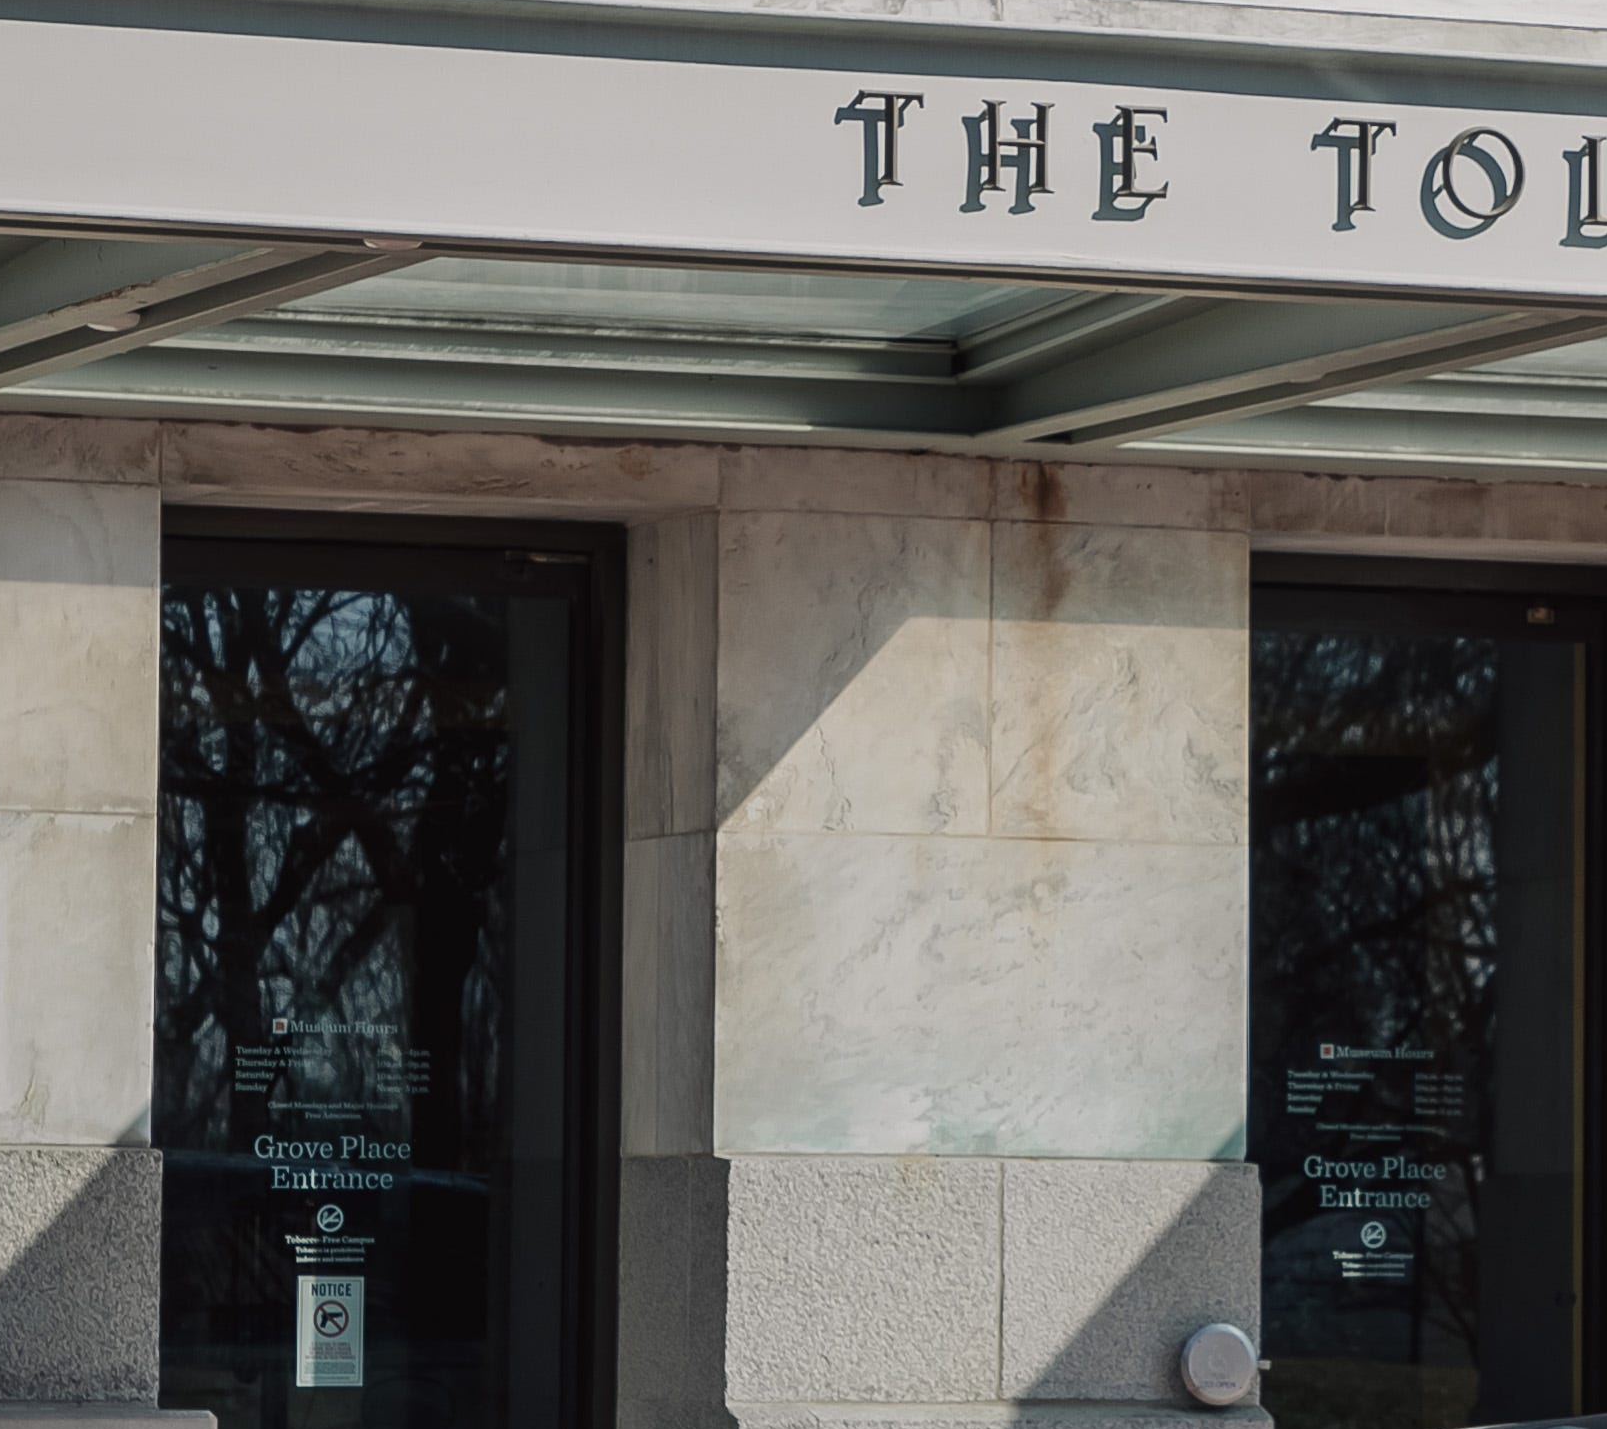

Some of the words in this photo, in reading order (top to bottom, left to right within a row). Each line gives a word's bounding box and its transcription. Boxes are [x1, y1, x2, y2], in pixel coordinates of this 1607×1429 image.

[852, 88, 1171, 201] THE
[291, 1020, 350, 1034] Museum
[355, 1021, 398, 1035] Hours
[235, 1046, 273, 1057] Tuesday
[1336, 1046, 1392, 1059] Museum
[254, 1134, 334, 1160] Grove
[340, 1134, 412, 1160] Place
[270, 1165, 394, 1190] Entrance
[1303, 1155, 1377, 1179] Grove
[1382, 1155, 1448, 1181] Place
[1319, 1183, 1432, 1209] Entrance
[311, 1283, 352, 1297] NOTICE
